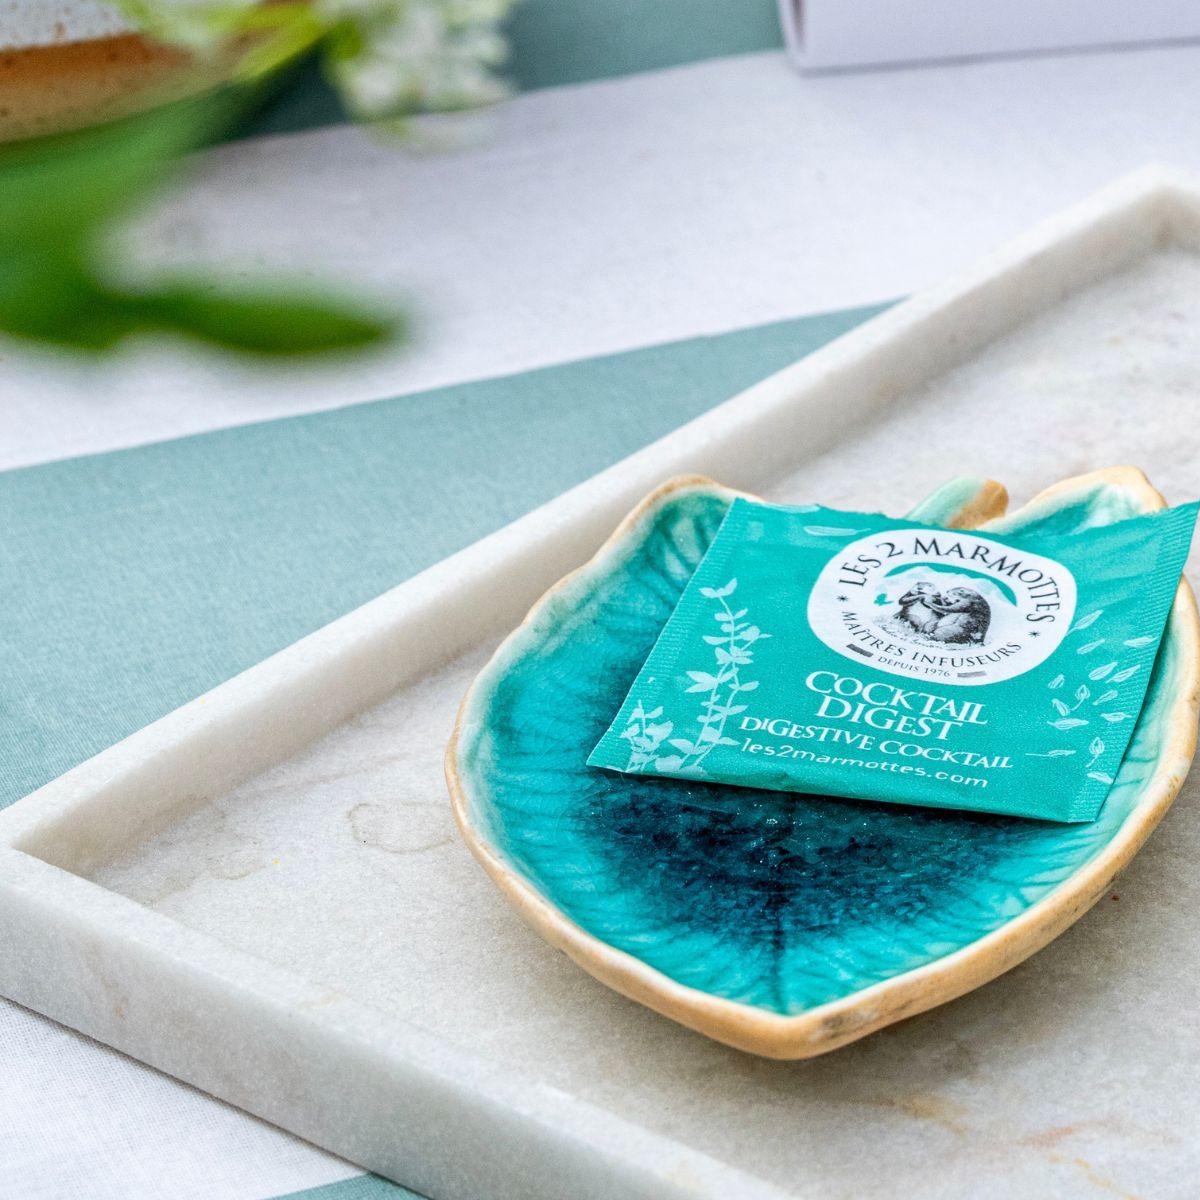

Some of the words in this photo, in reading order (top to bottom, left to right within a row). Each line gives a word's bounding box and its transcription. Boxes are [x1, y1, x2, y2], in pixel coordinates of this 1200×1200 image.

[838, 554, 882, 588] LES
[876, 541, 903, 559] 2
[914, 537, 1062, 623] MARMOTTES
[842, 611, 903, 657] MAÎTRES
[911, 641, 1022, 668] INFUSEURS
[877, 655, 920, 672] DEPUIS
[924, 666, 951, 677] 1976
[805, 670, 988, 725] COCKTAIL
[816, 695, 964, 741] DIGEST
[738, 716, 876, 751] DIGESTIVE
[878, 740, 1014, 769] COCKTAIL
[740, 738, 988, 788] les2marmottes.com
